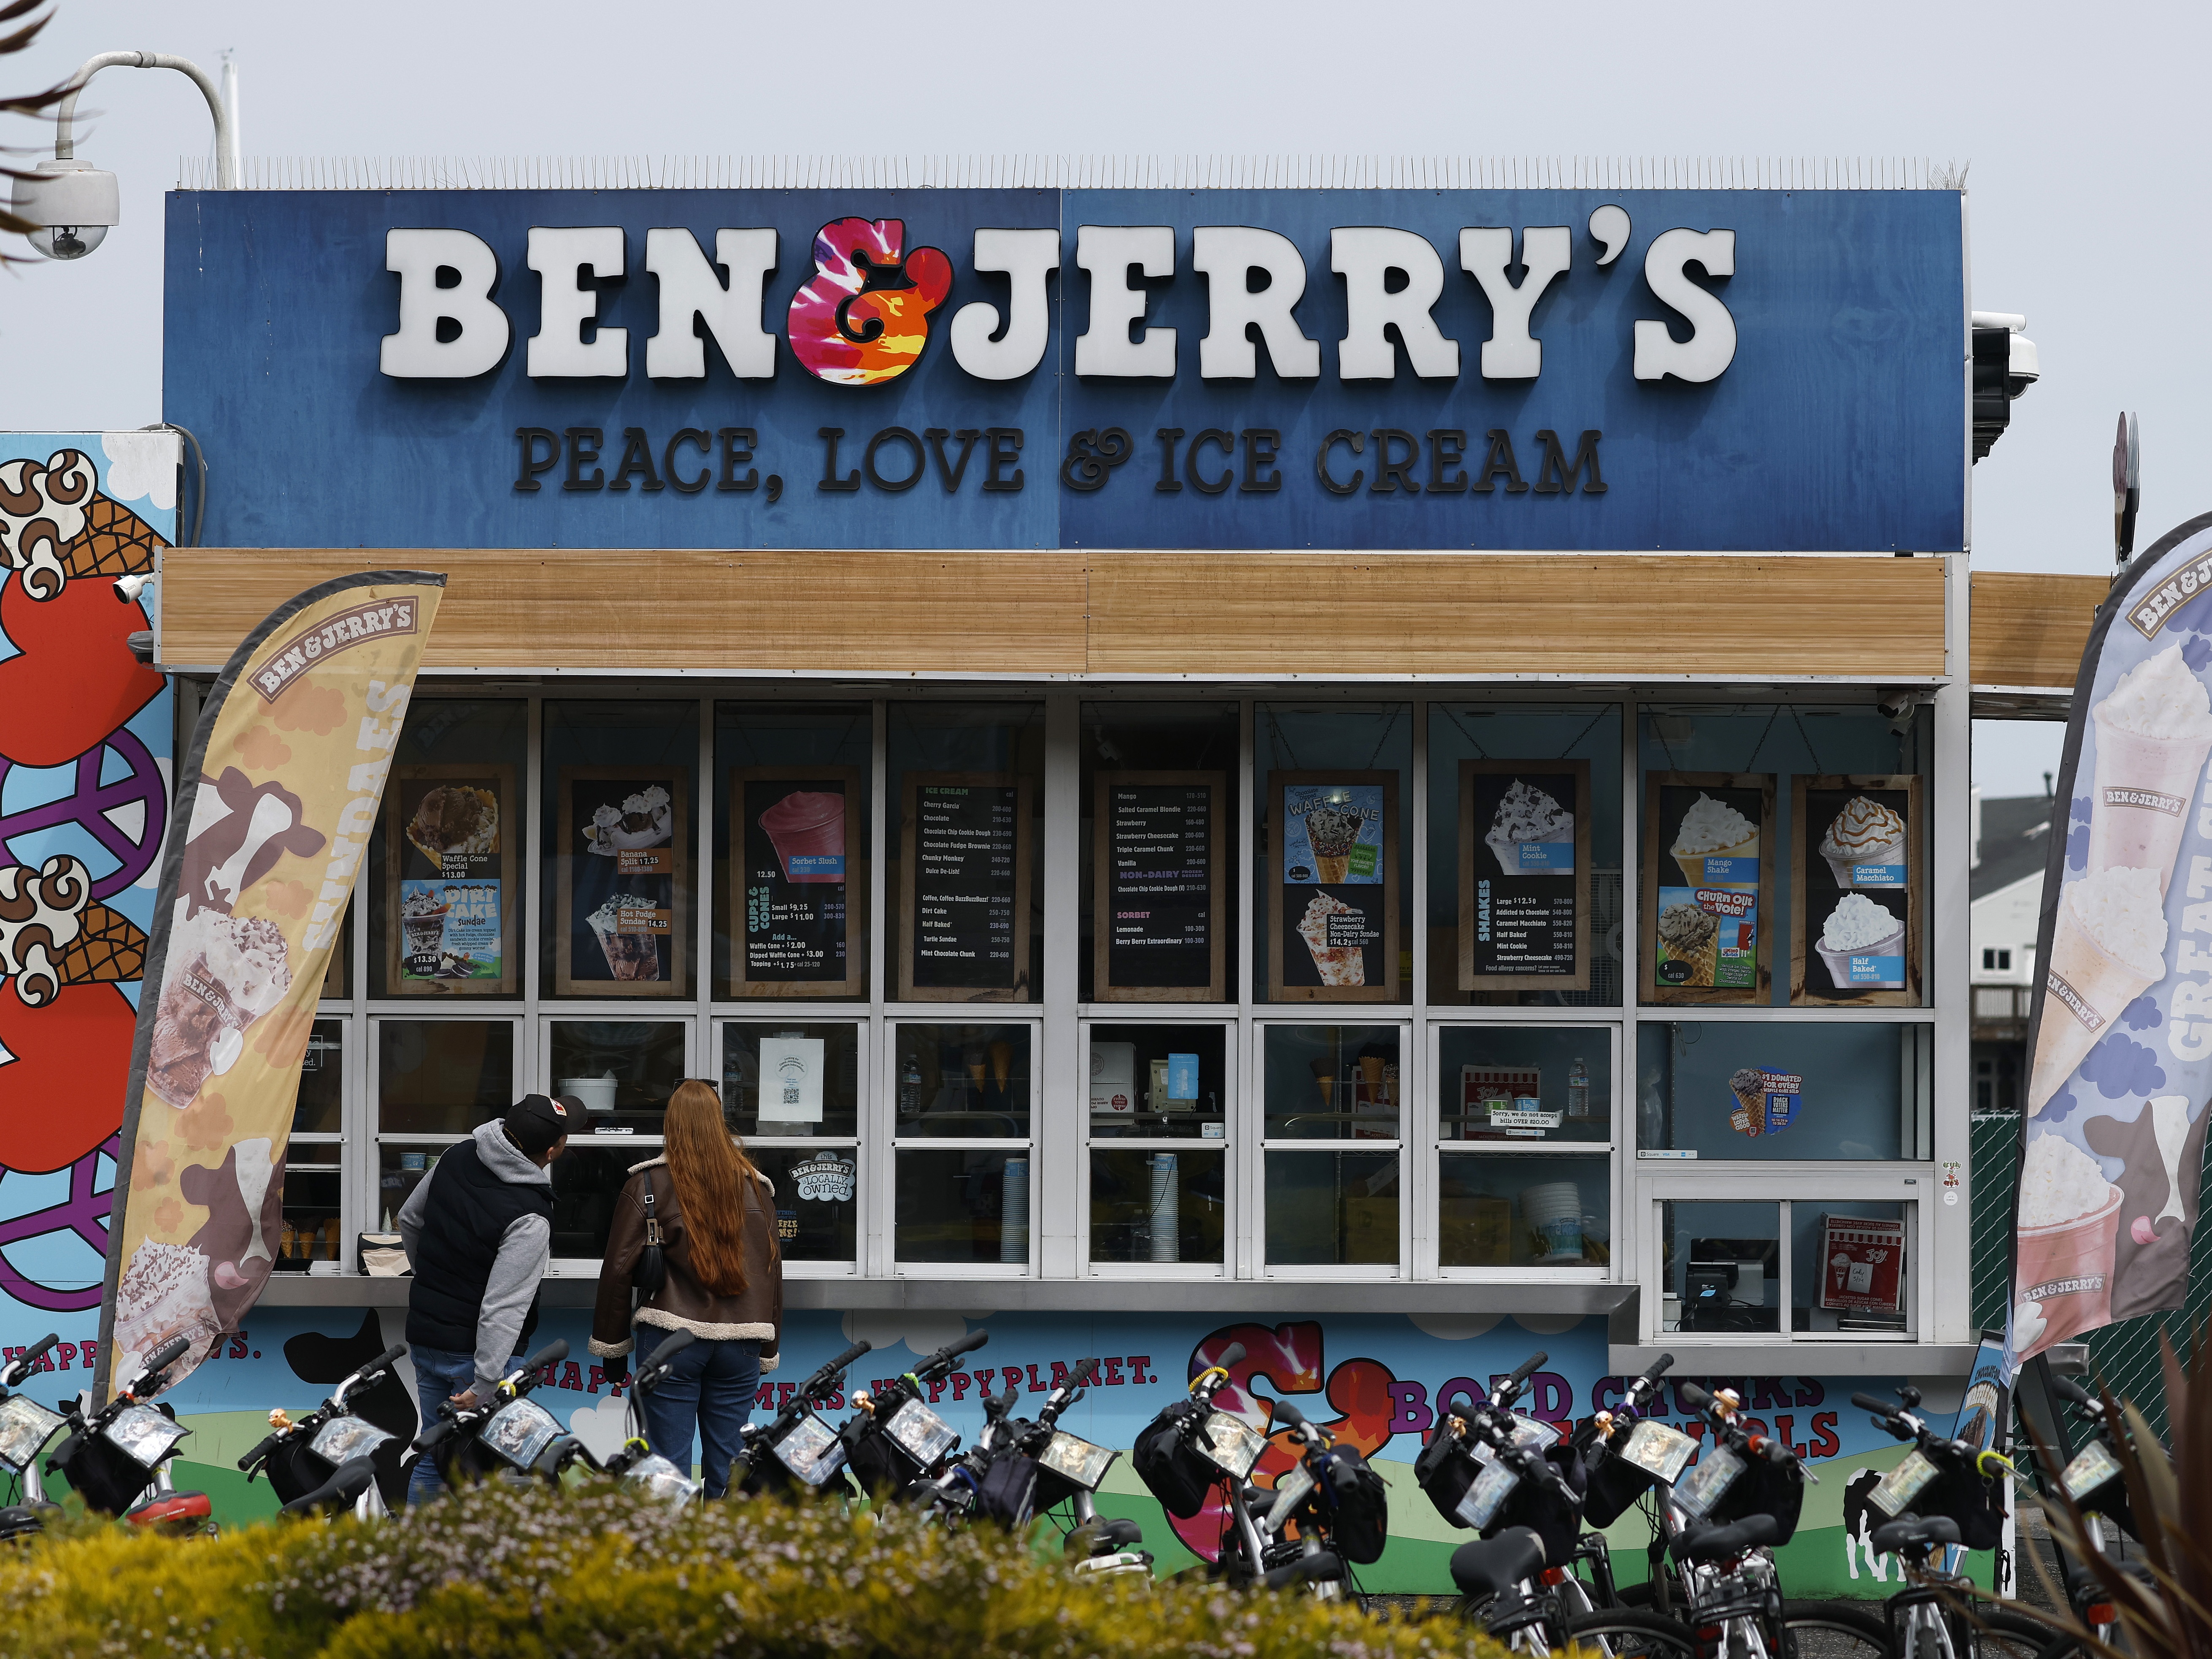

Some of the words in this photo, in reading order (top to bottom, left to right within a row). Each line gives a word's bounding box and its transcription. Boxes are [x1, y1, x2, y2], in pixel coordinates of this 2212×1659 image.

[515, 427, 783, 502] PEACE,
[817, 426, 1024, 492] LOVE
[1061, 427, 1134, 491] &
[1156, 428, 1282, 493] ICE
[1317, 428, 1607, 494] CREAM
[1340, 804, 1380, 821] CONE
[1120, 870, 1179, 878] NON-DAIRY
[443, 885, 497, 902] DIRT
[748, 886, 758, 896] &
[445, 903, 497, 918] CAKE
[635, 911, 656, 919] Fudge
[749, 899, 759, 932] CUPS
[760, 886, 770, 929] CONES
[1478, 879, 1491, 942] SHAKES
[414, 956, 436, 964] $13.50
[806, 1175, 848, 1185] LOCALLY
[803, 1183, 848, 1197] owned.
[2, 1340, 97, 1372] HAPP
[535, 1359, 632, 1397] HAPP
[870, 1368, 995, 1404] HPPY
[1002, 1356, 1157, 1393] PLANET.
